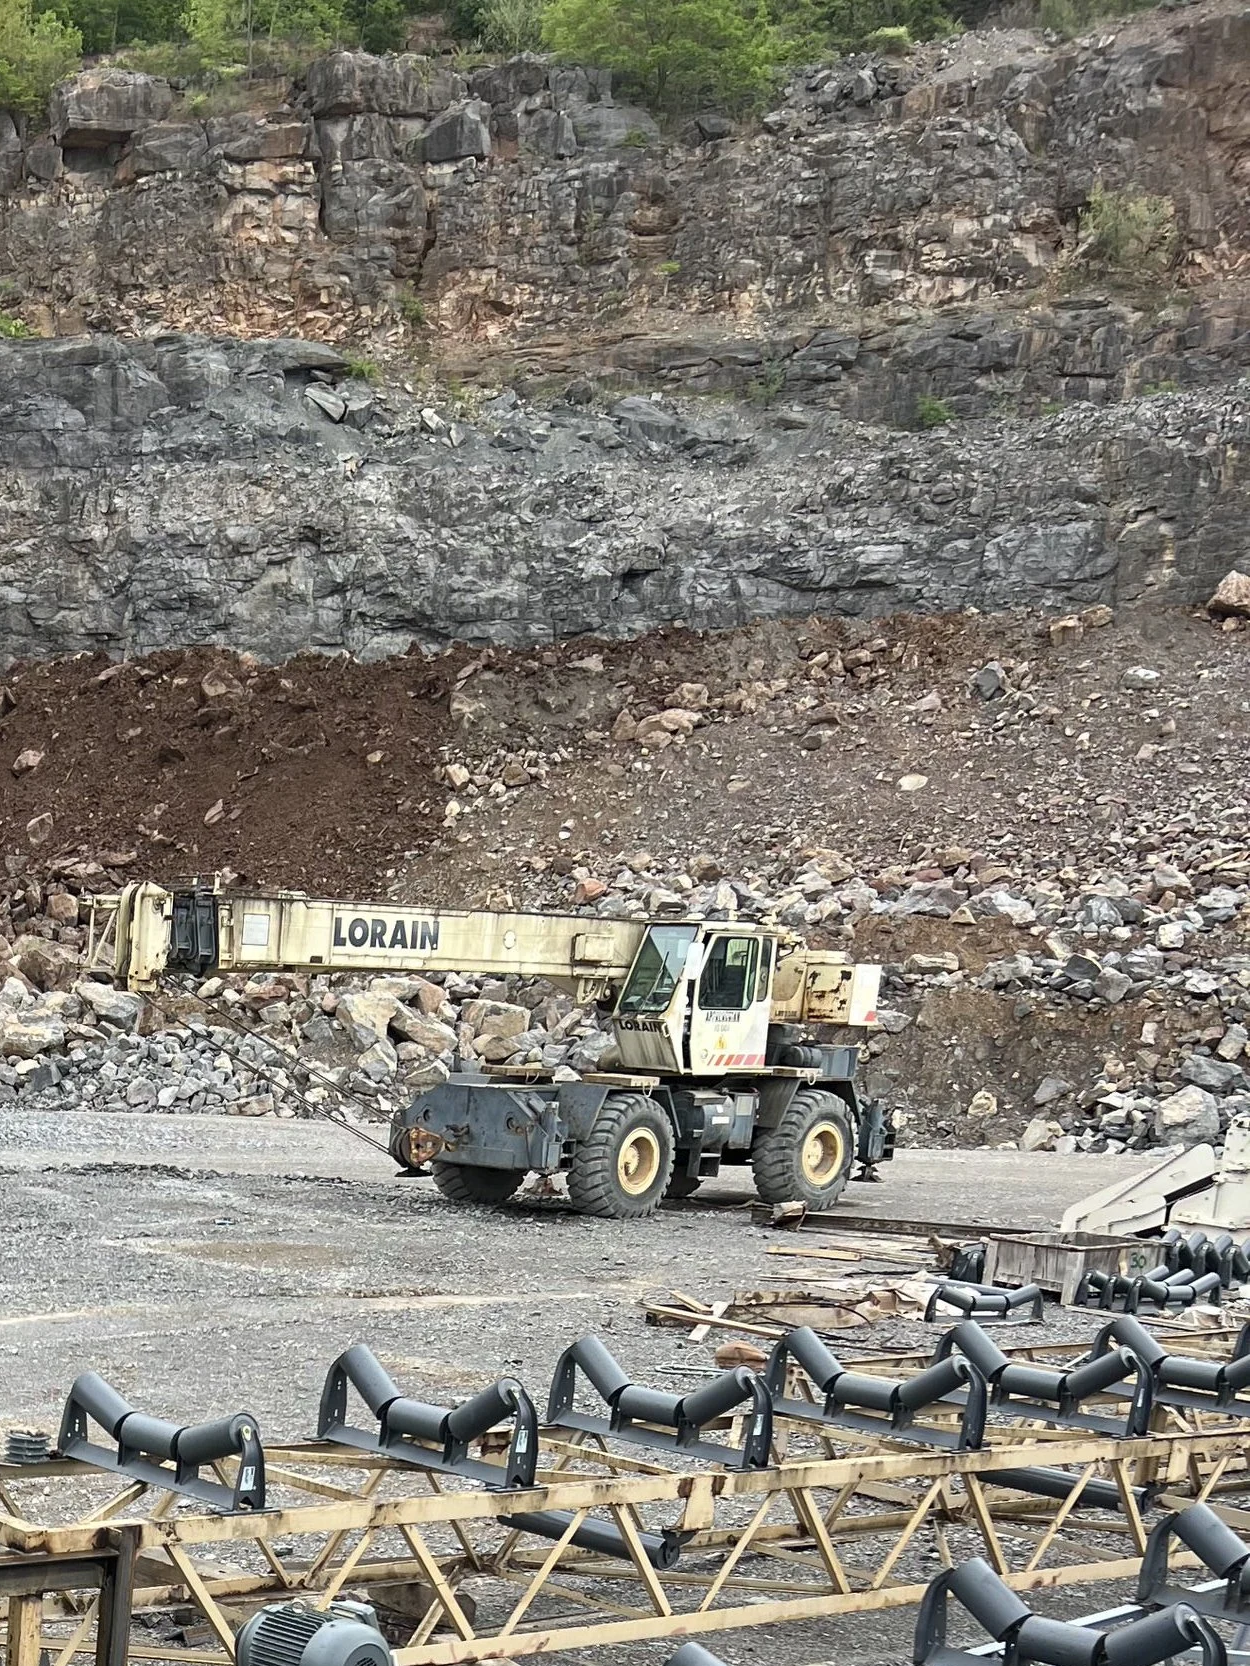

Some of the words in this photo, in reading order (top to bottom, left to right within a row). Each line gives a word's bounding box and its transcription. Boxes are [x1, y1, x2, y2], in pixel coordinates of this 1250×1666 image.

[333, 917, 440, 950] LORAIN
[618, 1018, 663, 1034] LORAIN
[1130, 1252, 1147, 1269] 30
